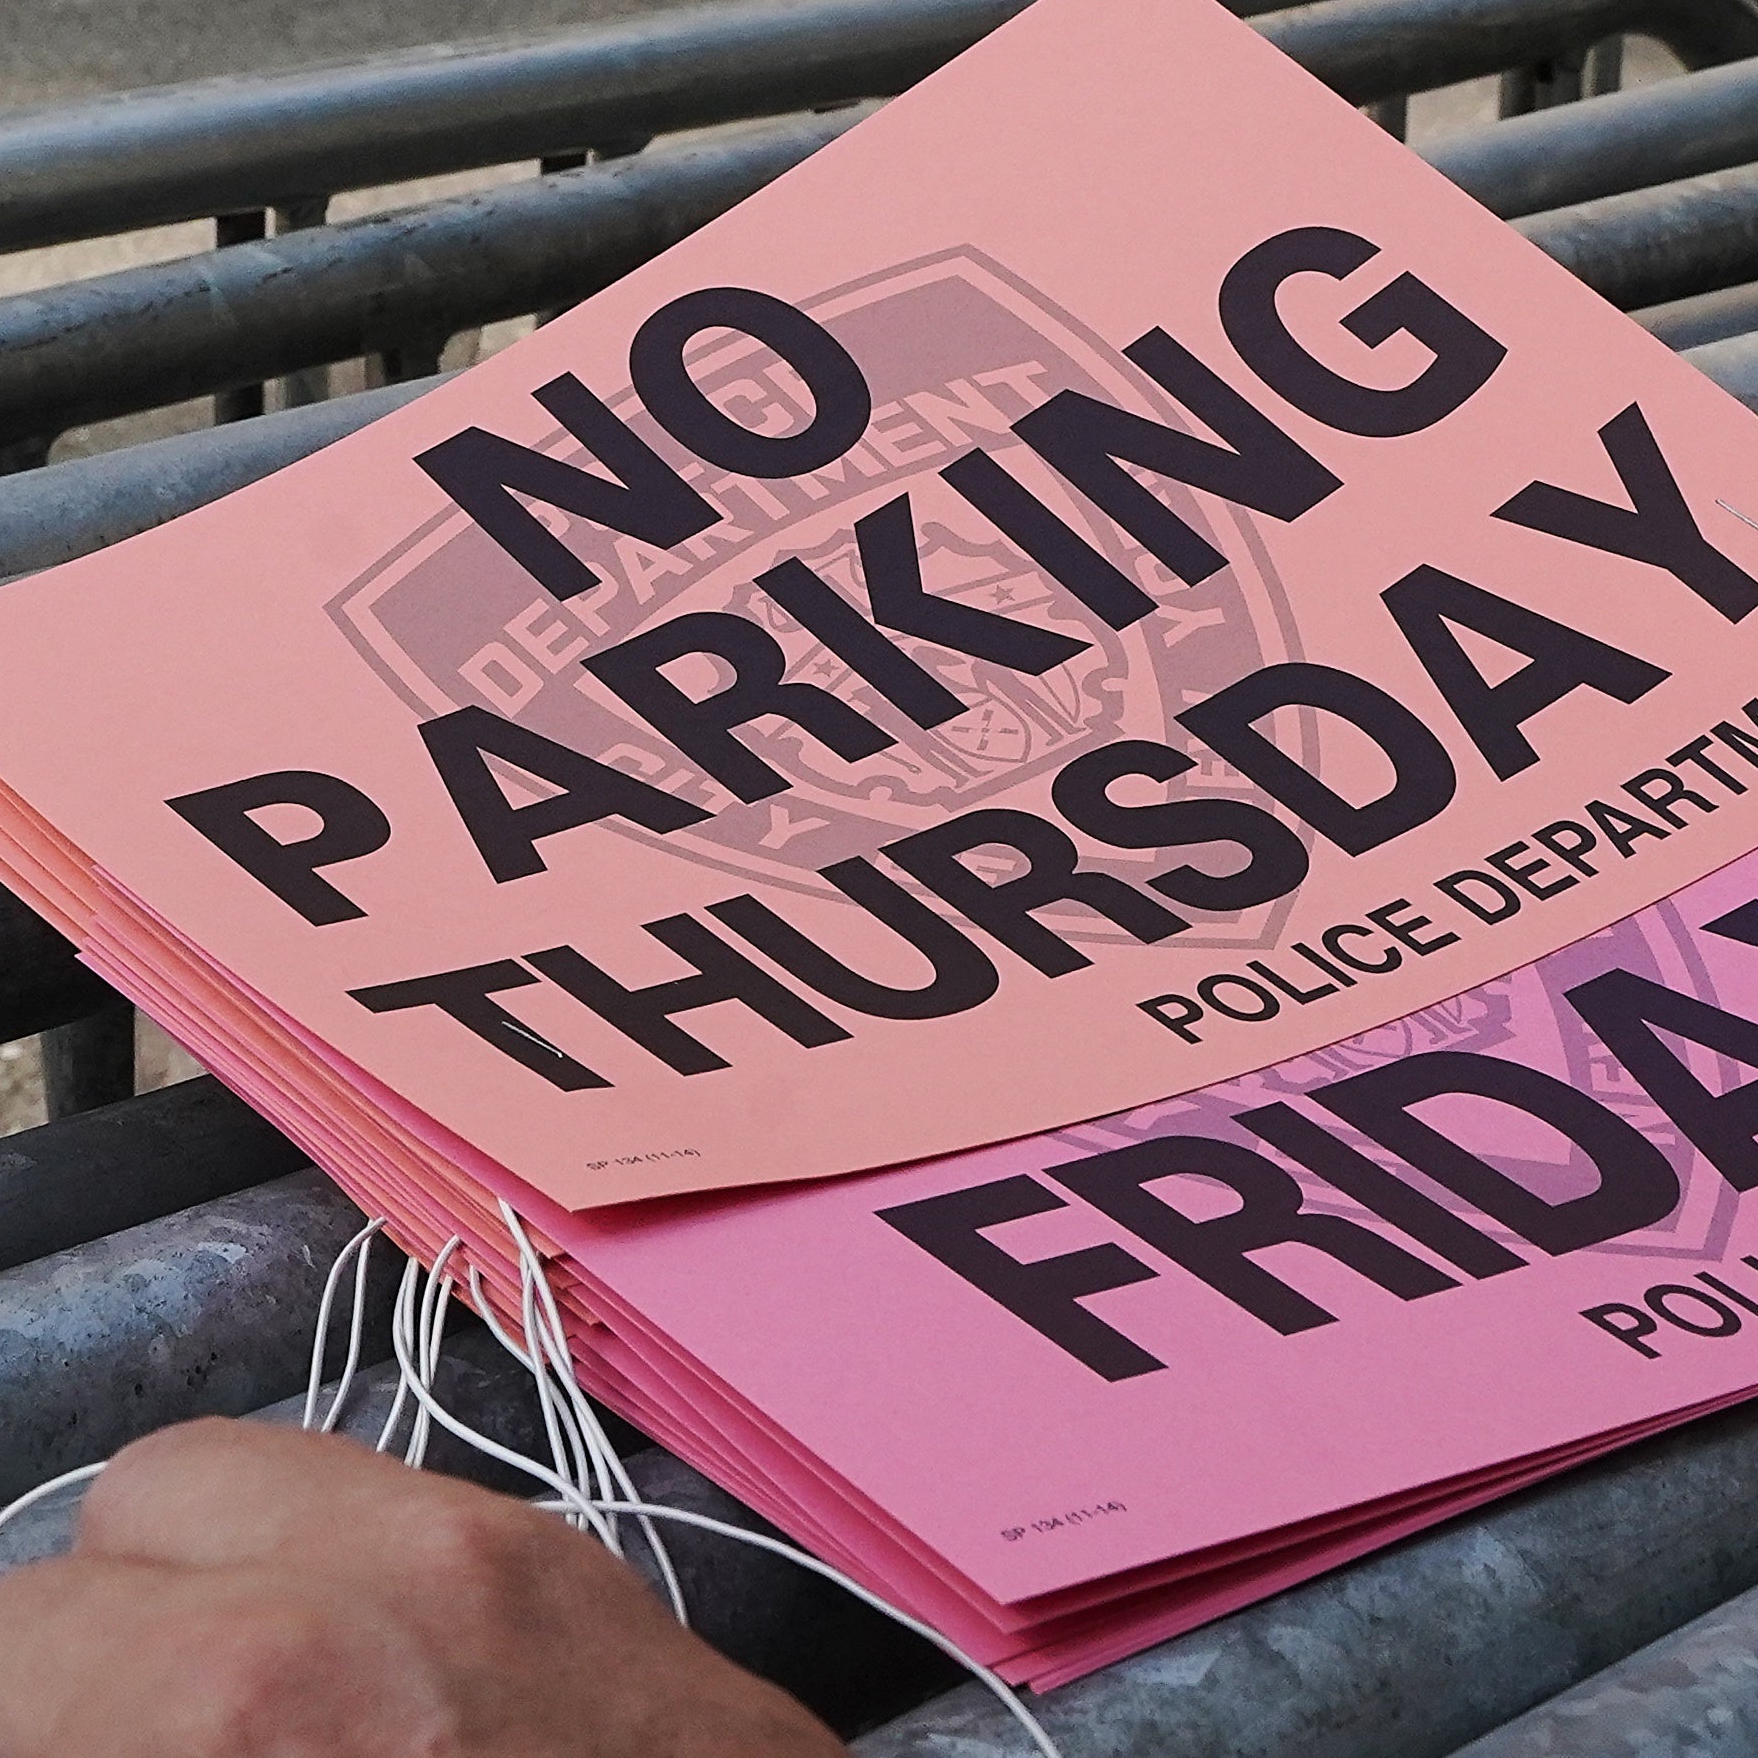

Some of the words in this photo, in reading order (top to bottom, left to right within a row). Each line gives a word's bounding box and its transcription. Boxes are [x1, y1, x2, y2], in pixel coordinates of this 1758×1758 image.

[164, 226, 1507, 927] PARKING
[413, 287, 871, 602] NO
[1136, 898, 1461, 1044] POLICE
